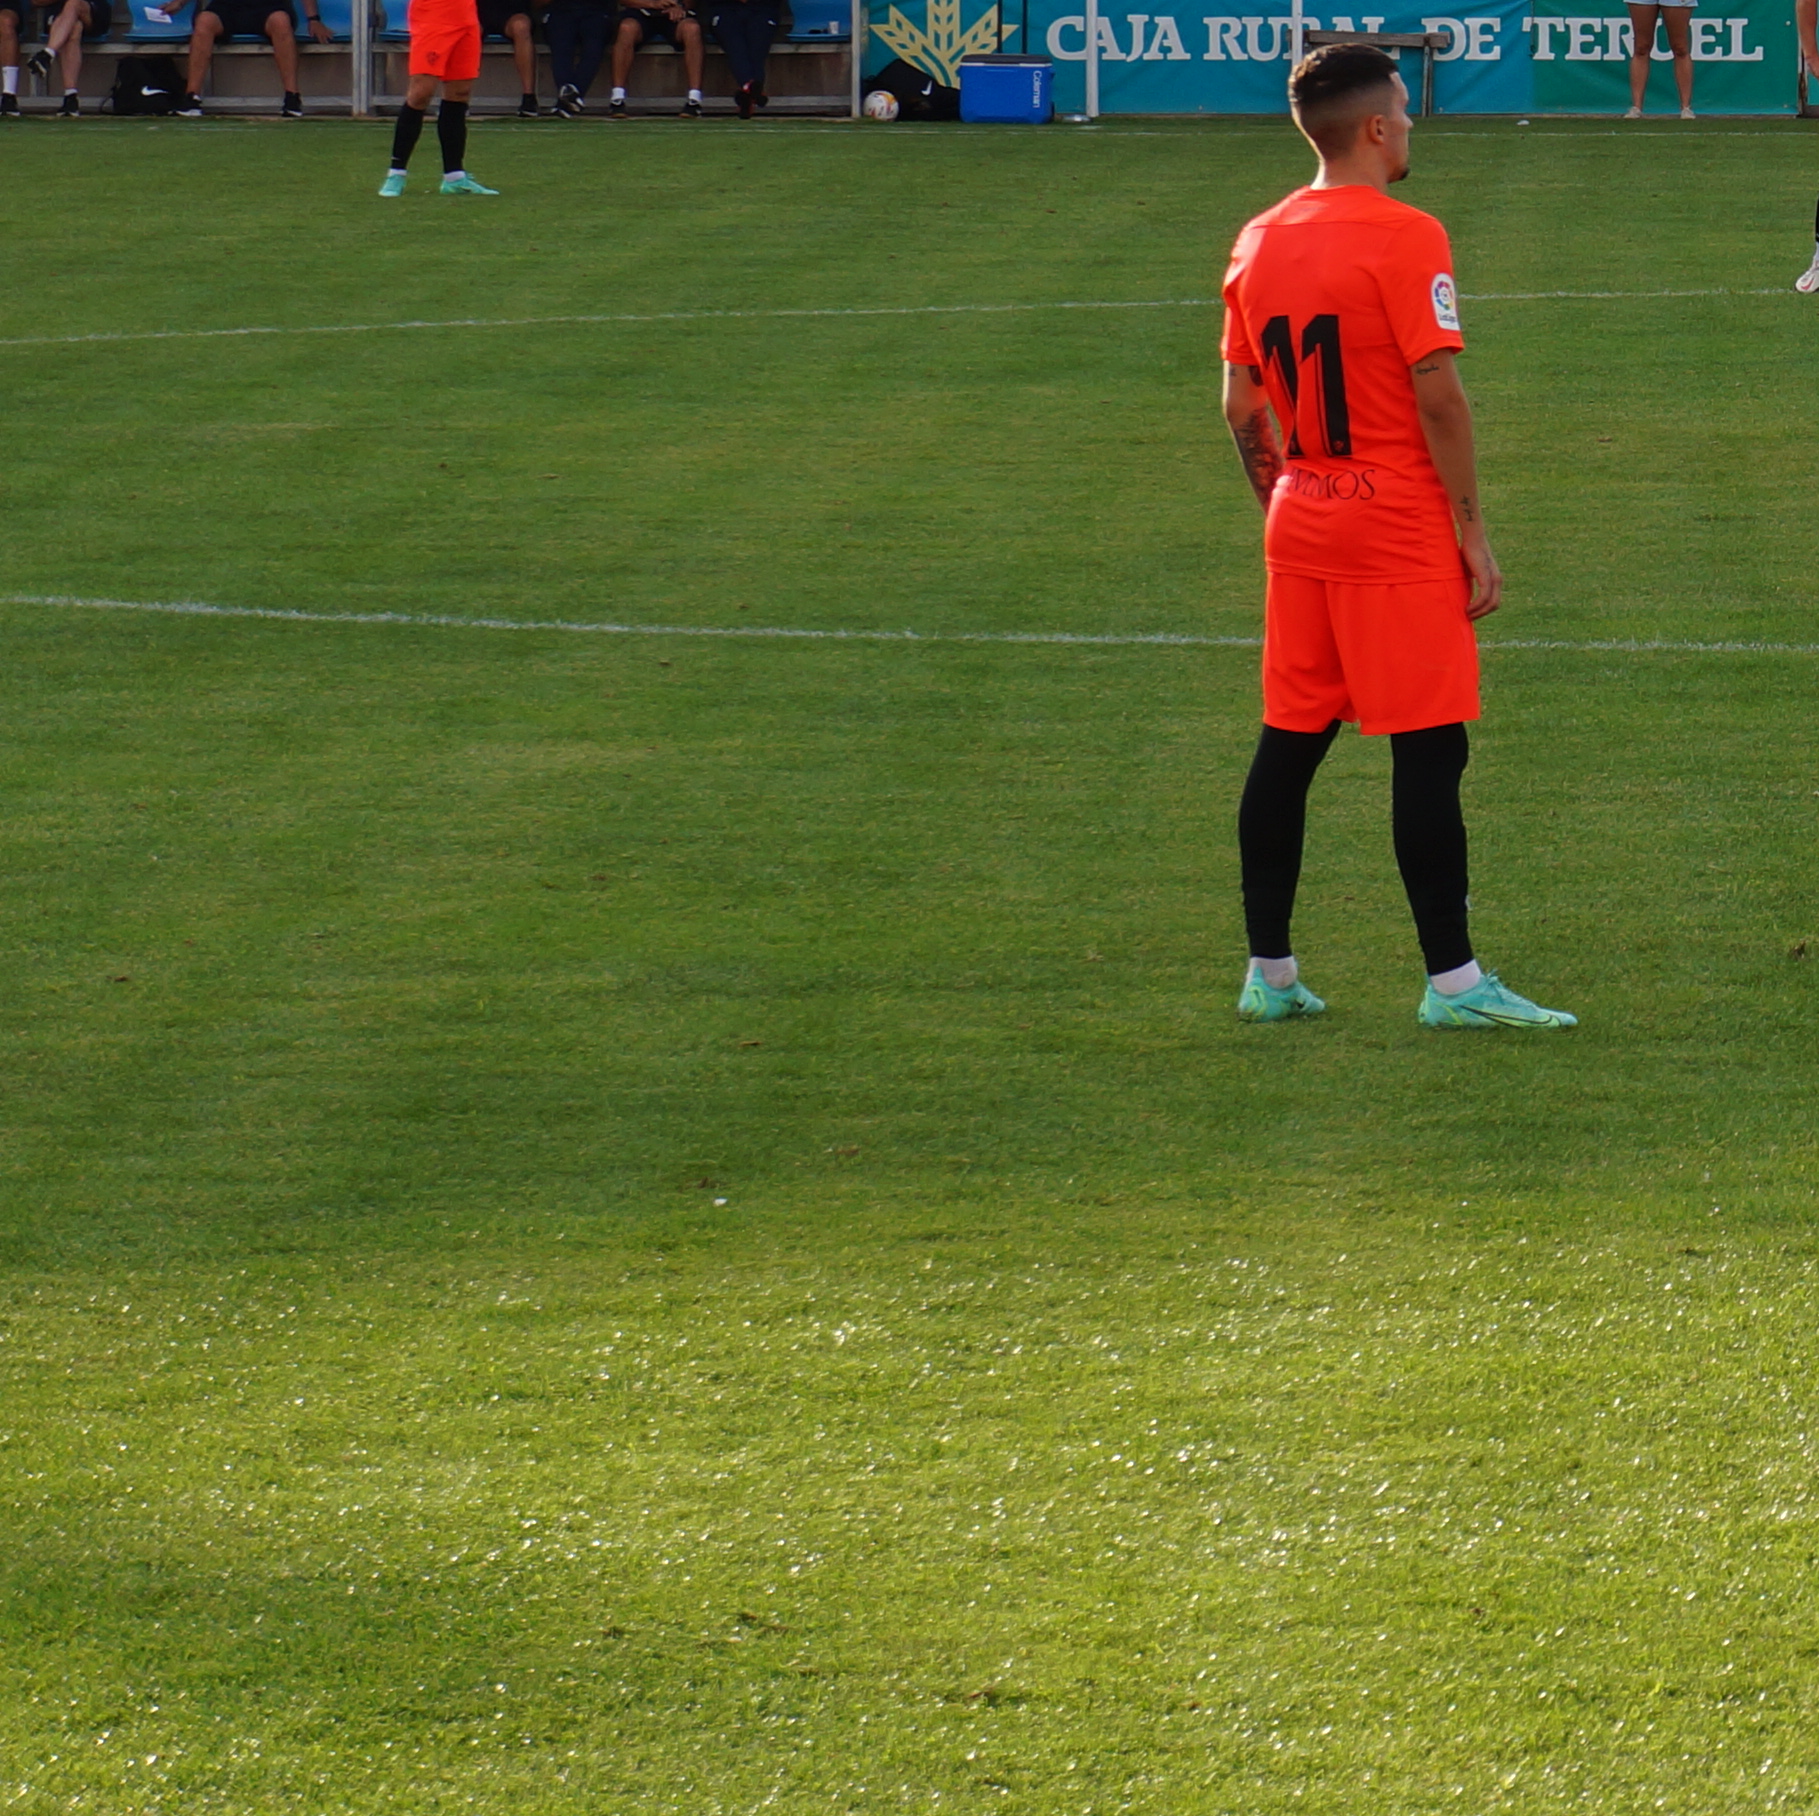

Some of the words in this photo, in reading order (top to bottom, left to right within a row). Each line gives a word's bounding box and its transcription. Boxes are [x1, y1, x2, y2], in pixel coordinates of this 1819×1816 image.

[1046, 14, 1191, 62] CAJA
[1421, 17, 1500, 60] DE
[1260, 314, 1353, 459] 11
